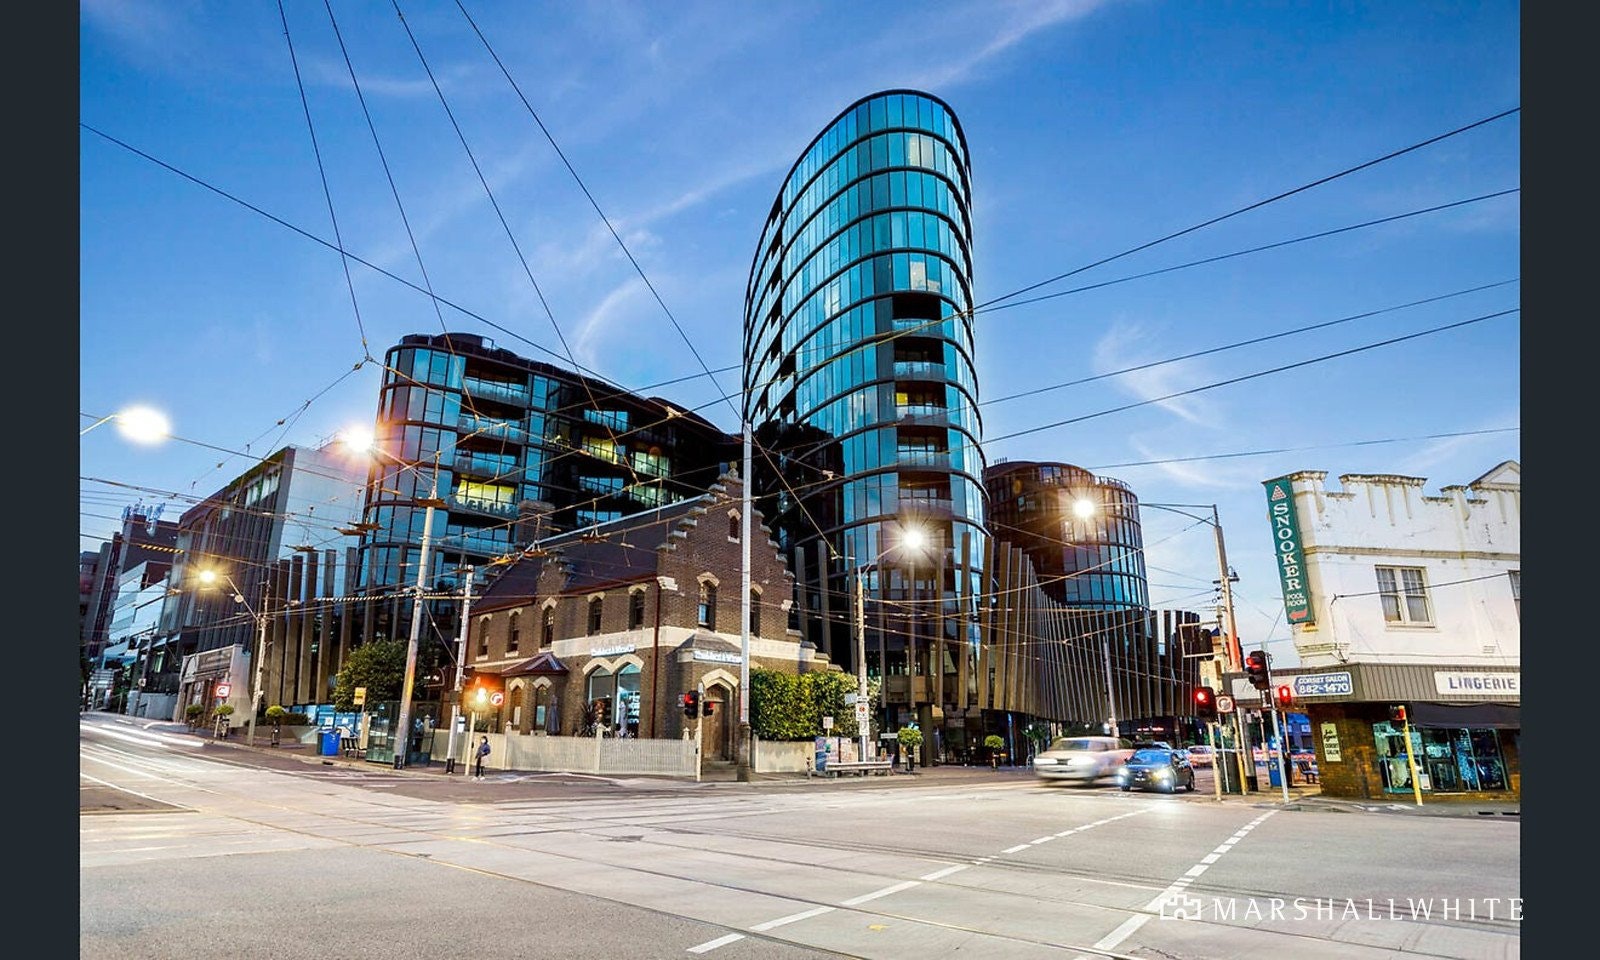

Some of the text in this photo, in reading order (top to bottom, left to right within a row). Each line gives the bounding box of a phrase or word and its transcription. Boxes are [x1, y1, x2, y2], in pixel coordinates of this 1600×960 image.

[1273, 502, 1302, 591] SNOOKER
[1325, 674, 1348, 683] SALON
[1448, 677, 1517, 690] LINGERIE
[1299, 683, 1349, 694] 882-1470
